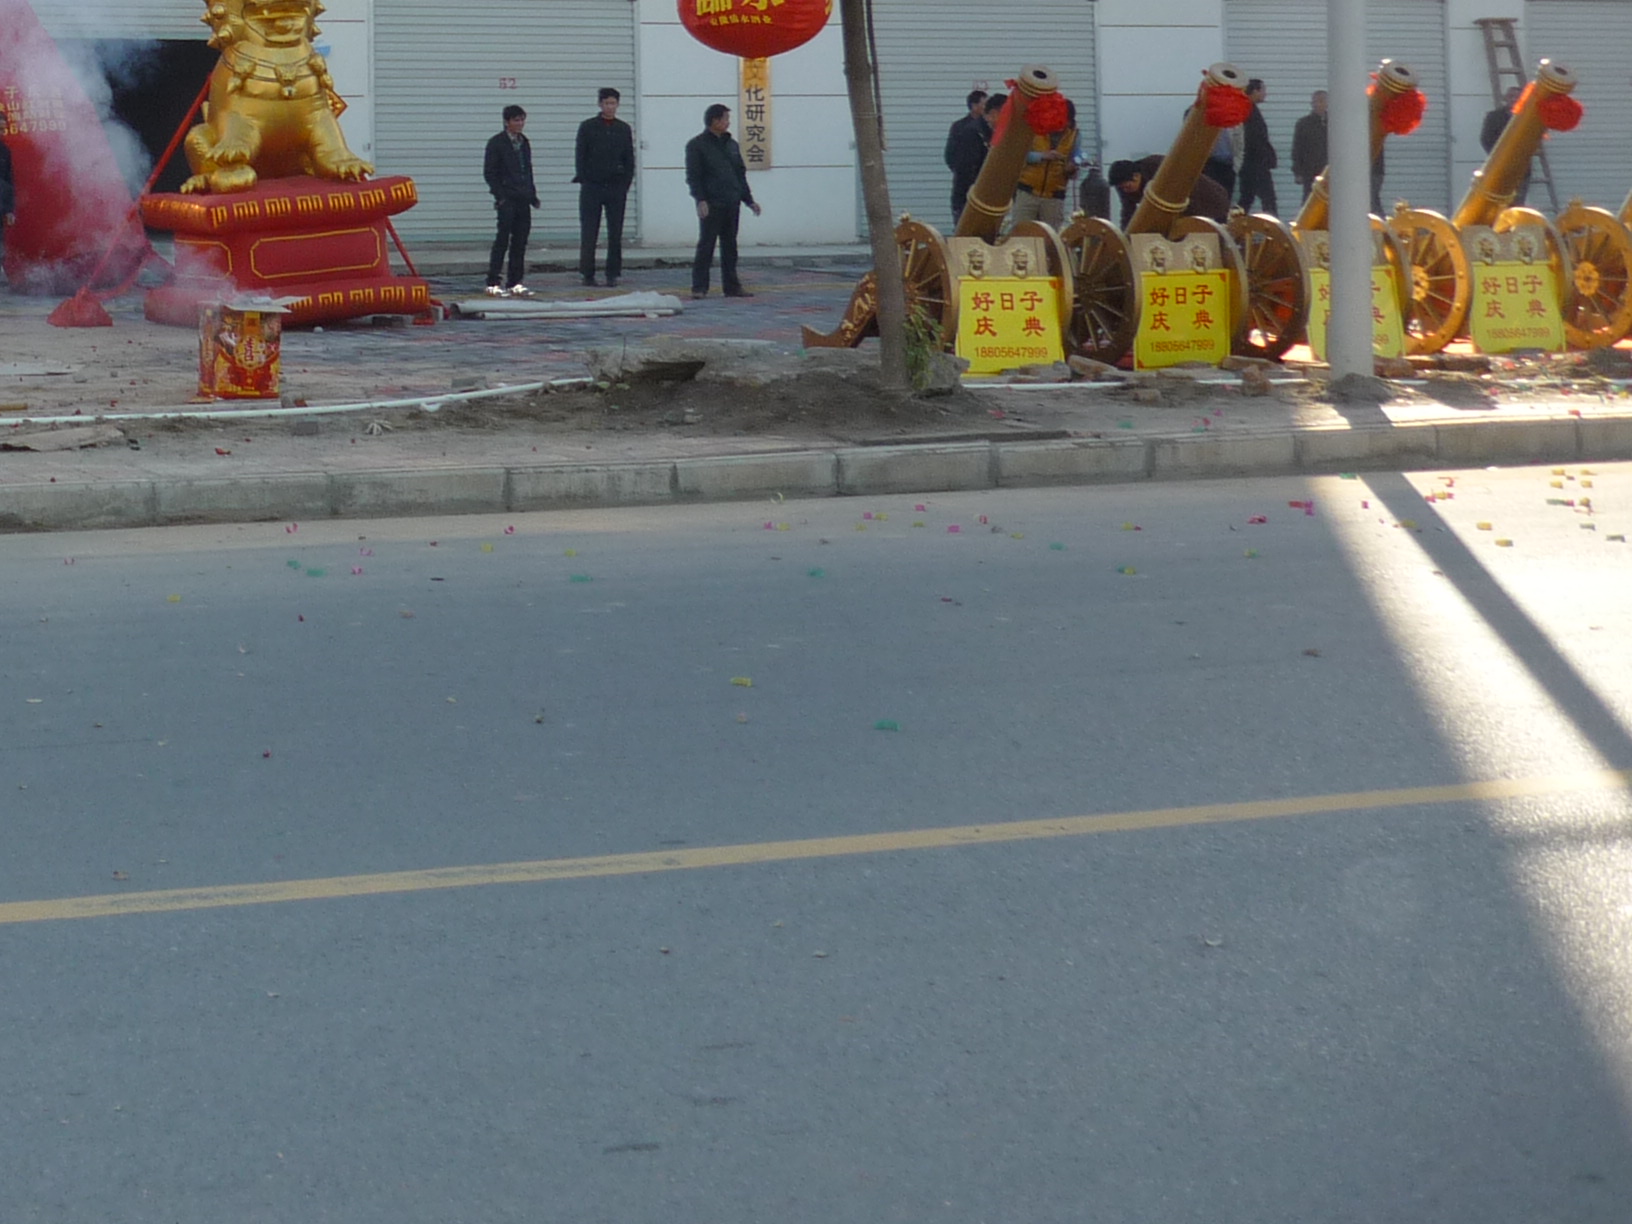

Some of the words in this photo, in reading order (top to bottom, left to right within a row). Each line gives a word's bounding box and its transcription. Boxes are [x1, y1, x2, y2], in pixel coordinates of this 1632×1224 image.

[1480, 274, 1543, 295] 好日子
[971, 291, 1043, 312] 好日子
[1150, 284, 1214, 307] 好日子
[975, 346, 1048, 359] 18805647999
